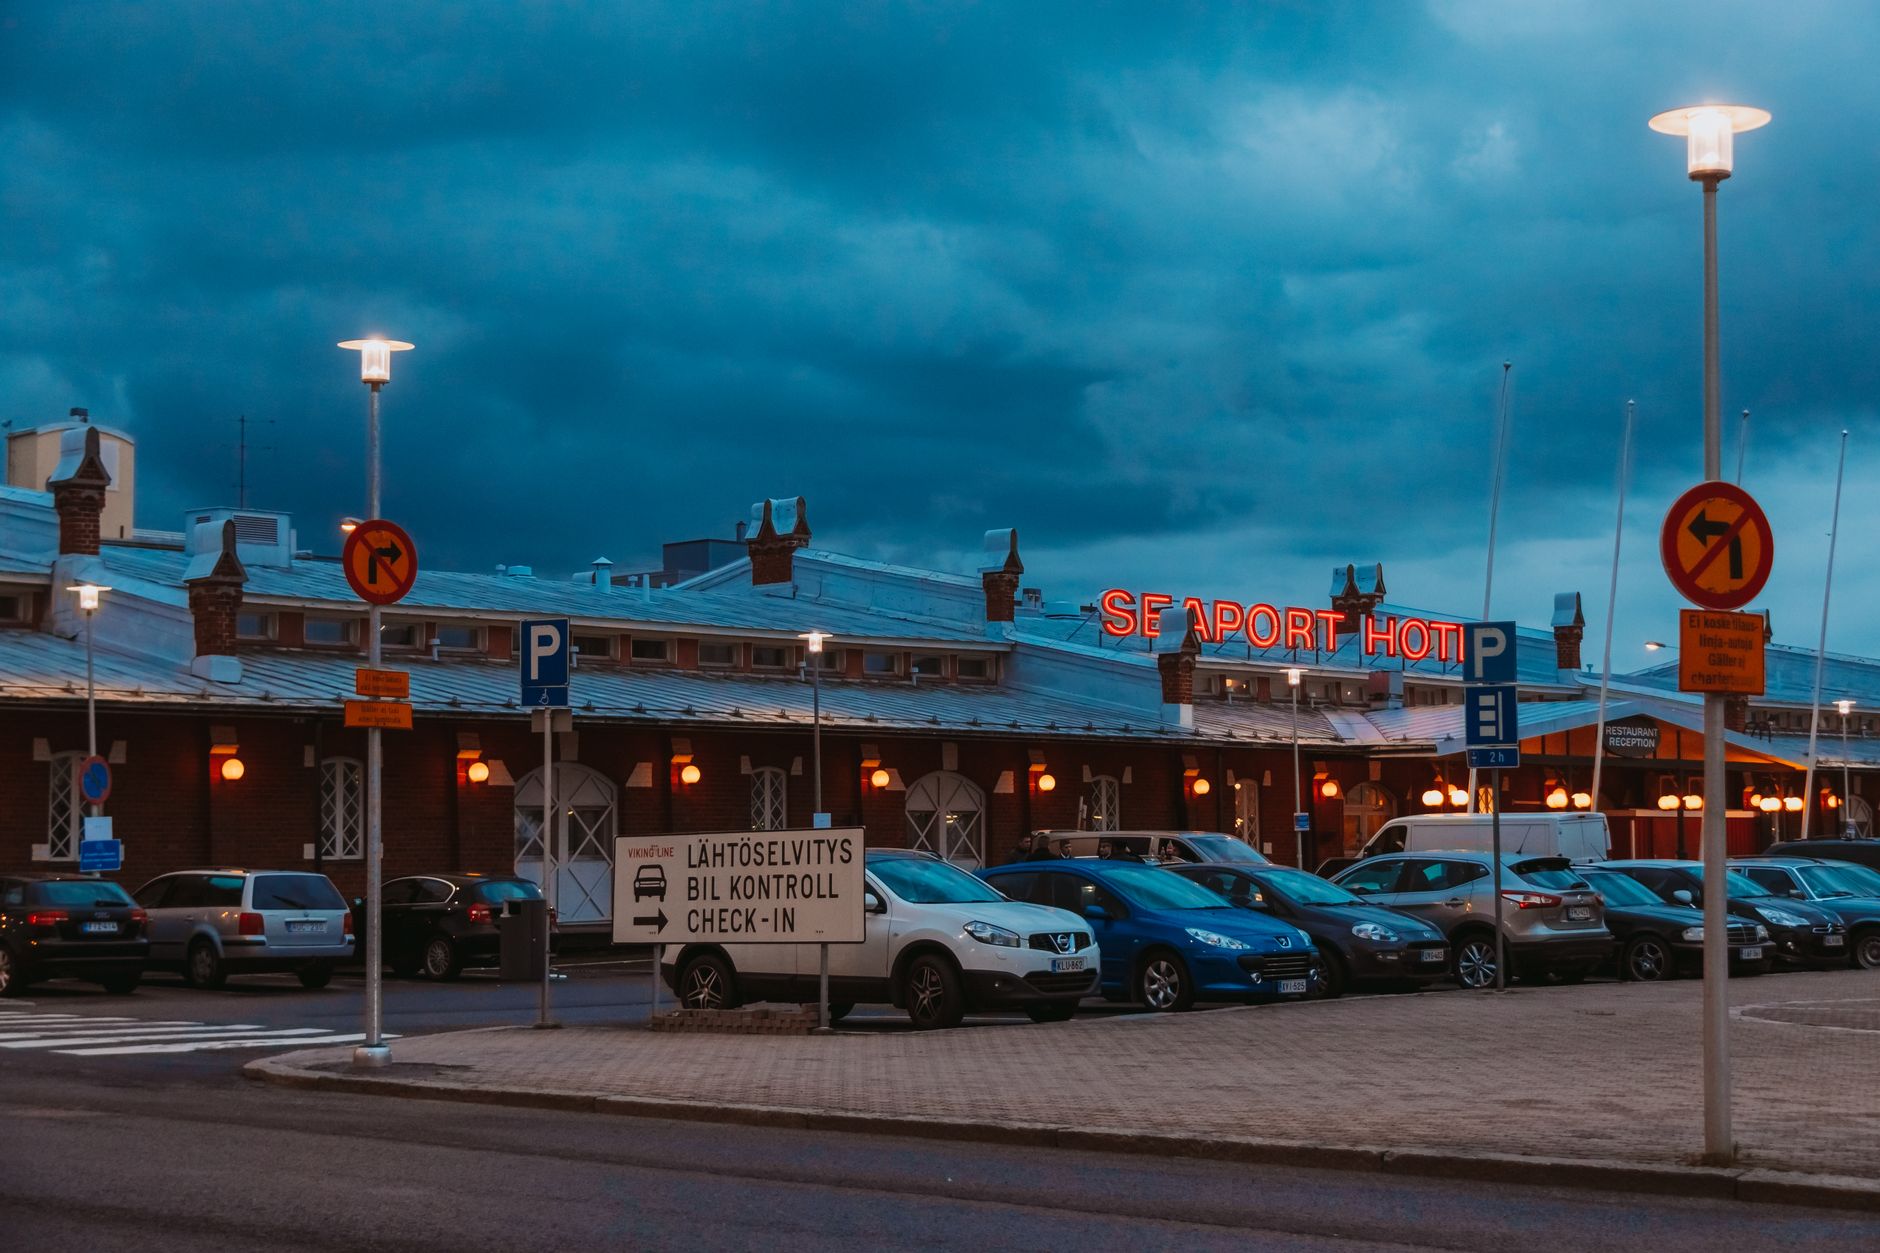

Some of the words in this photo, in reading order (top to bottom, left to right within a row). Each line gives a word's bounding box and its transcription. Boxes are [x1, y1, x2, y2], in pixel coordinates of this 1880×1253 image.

[1100, 588, 1346, 653] SEAPORT
[1365, 614, 1464, 664] HOT
[1689, 615, 1699, 628] Ei
[530, 624, 560, 680] P
[1473, 628, 1506, 678] P
[1605, 726, 1658, 737] RESTAURANT
[1609, 737, 1655, 747] RECEPTION
[1490, 752, 1496, 762] 2
[1498, 752, 1504, 762] h
[628, 847, 654, 858] VIKING
[657, 846, 674, 857] LINE
[687, 837, 853, 868] LÄHTÖSELVITYS
[687, 876, 720, 901] BIL
[730, 873, 839, 900] KONTROLL
[687, 908, 795, 933] CHECK-IN
